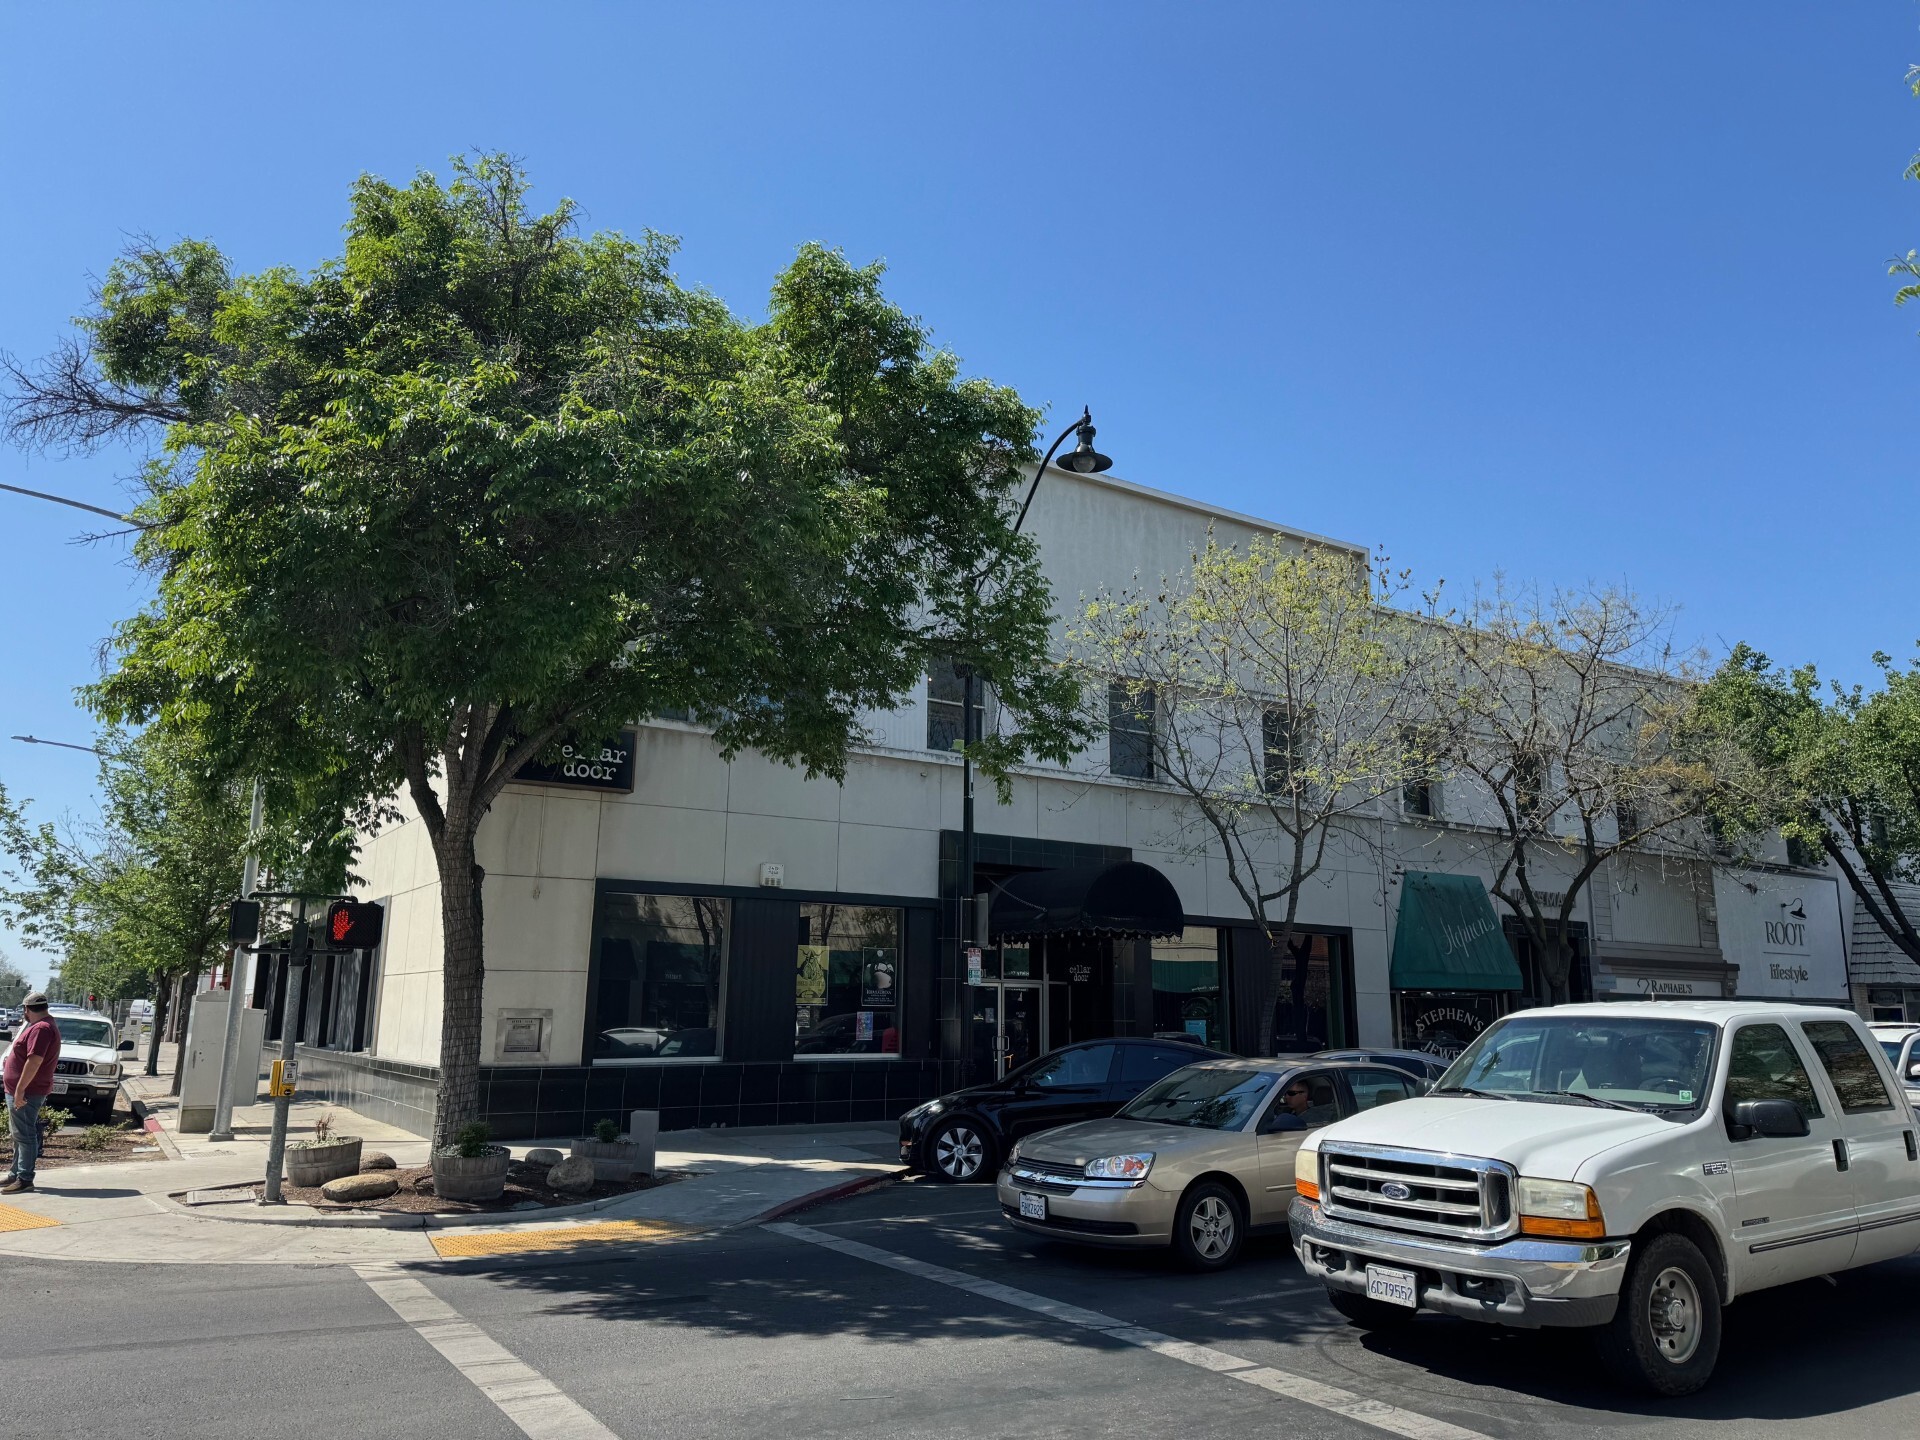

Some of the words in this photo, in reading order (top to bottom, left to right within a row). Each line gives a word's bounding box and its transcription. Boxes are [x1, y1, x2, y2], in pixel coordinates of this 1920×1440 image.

[563, 762, 617, 780] door
[1765, 921, 1805, 946] ROOT
[1069, 965, 1092, 975] cellar
[1073, 973, 1089, 982] door
[1770, 963, 1809, 984] lifestyle
[1650, 980, 1693, 994] RAPHAEL'S
[1415, 1007, 1484, 1032] STEPHEN'S
[1421, 1040, 1462, 1061] JEWE
[1371, 1280, 1413, 1302] 6C79552
